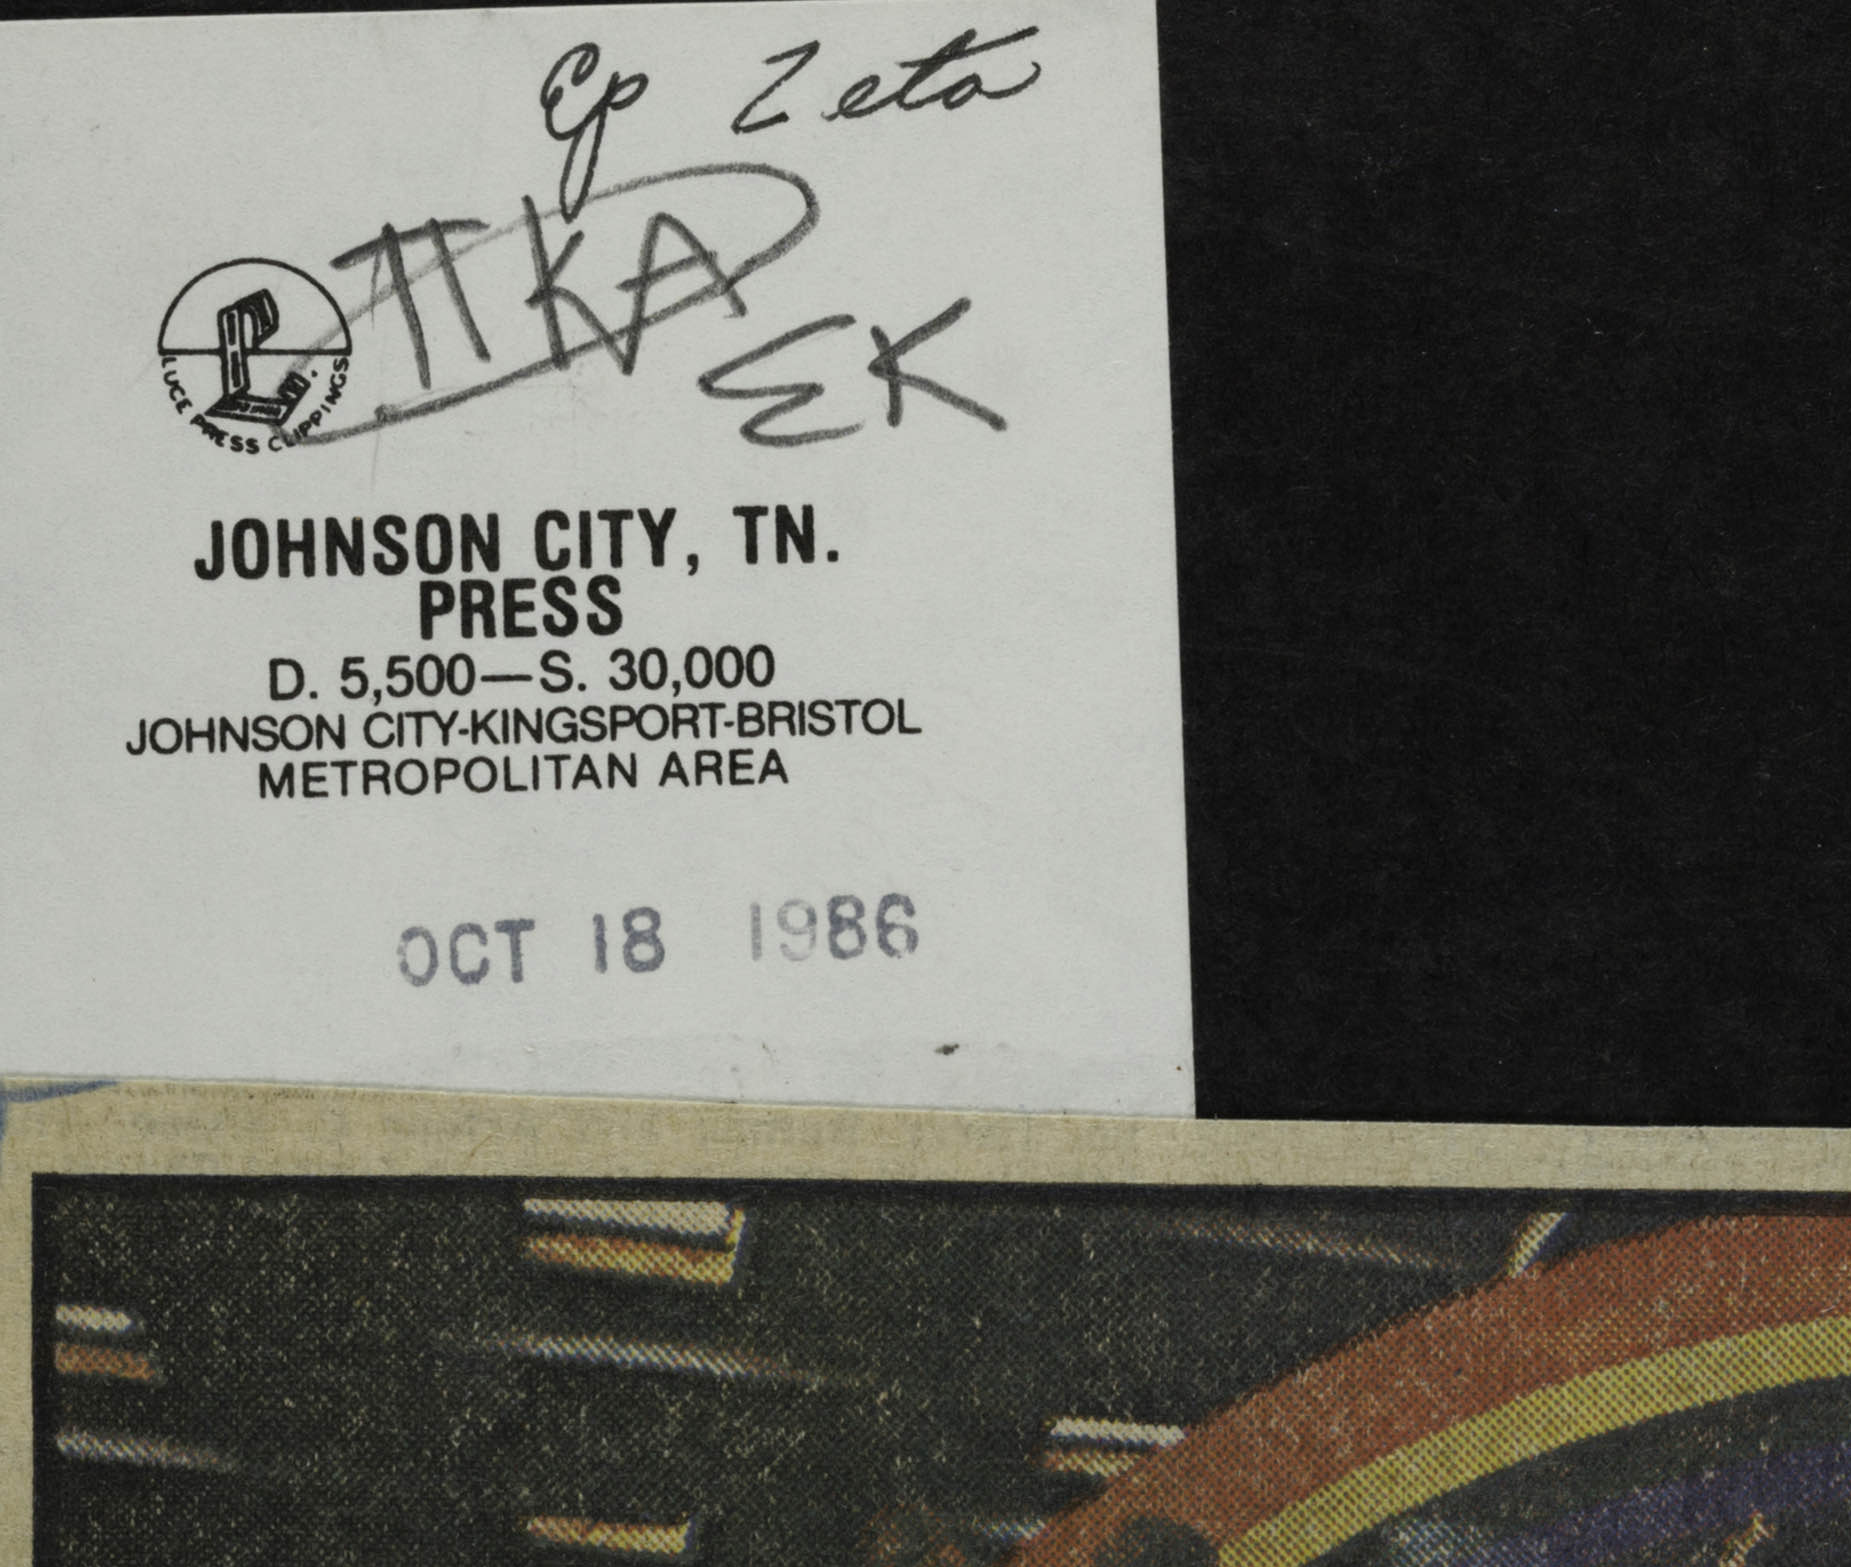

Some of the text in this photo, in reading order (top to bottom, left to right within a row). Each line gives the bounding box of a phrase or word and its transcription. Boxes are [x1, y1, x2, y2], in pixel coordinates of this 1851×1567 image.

[731, 26, 1042, 133] Zeta
[160, 356, 350, 455] LUCE PRESS CLIPPINGS
[193, 504, 841, 580] JOHNSON CITY, TN.
[419, 575, 624, 640] PRESS
[268, 658, 319, 701] D.
[609, 645, 776, 696] 30,000
[125, 698, 922, 755] JOHNSON CITY-KINGSPORT-BRISTOL
[257, 749, 790, 799] METROPOLITAN AREA
[396, 892, 919, 987] OCT 18 1986
